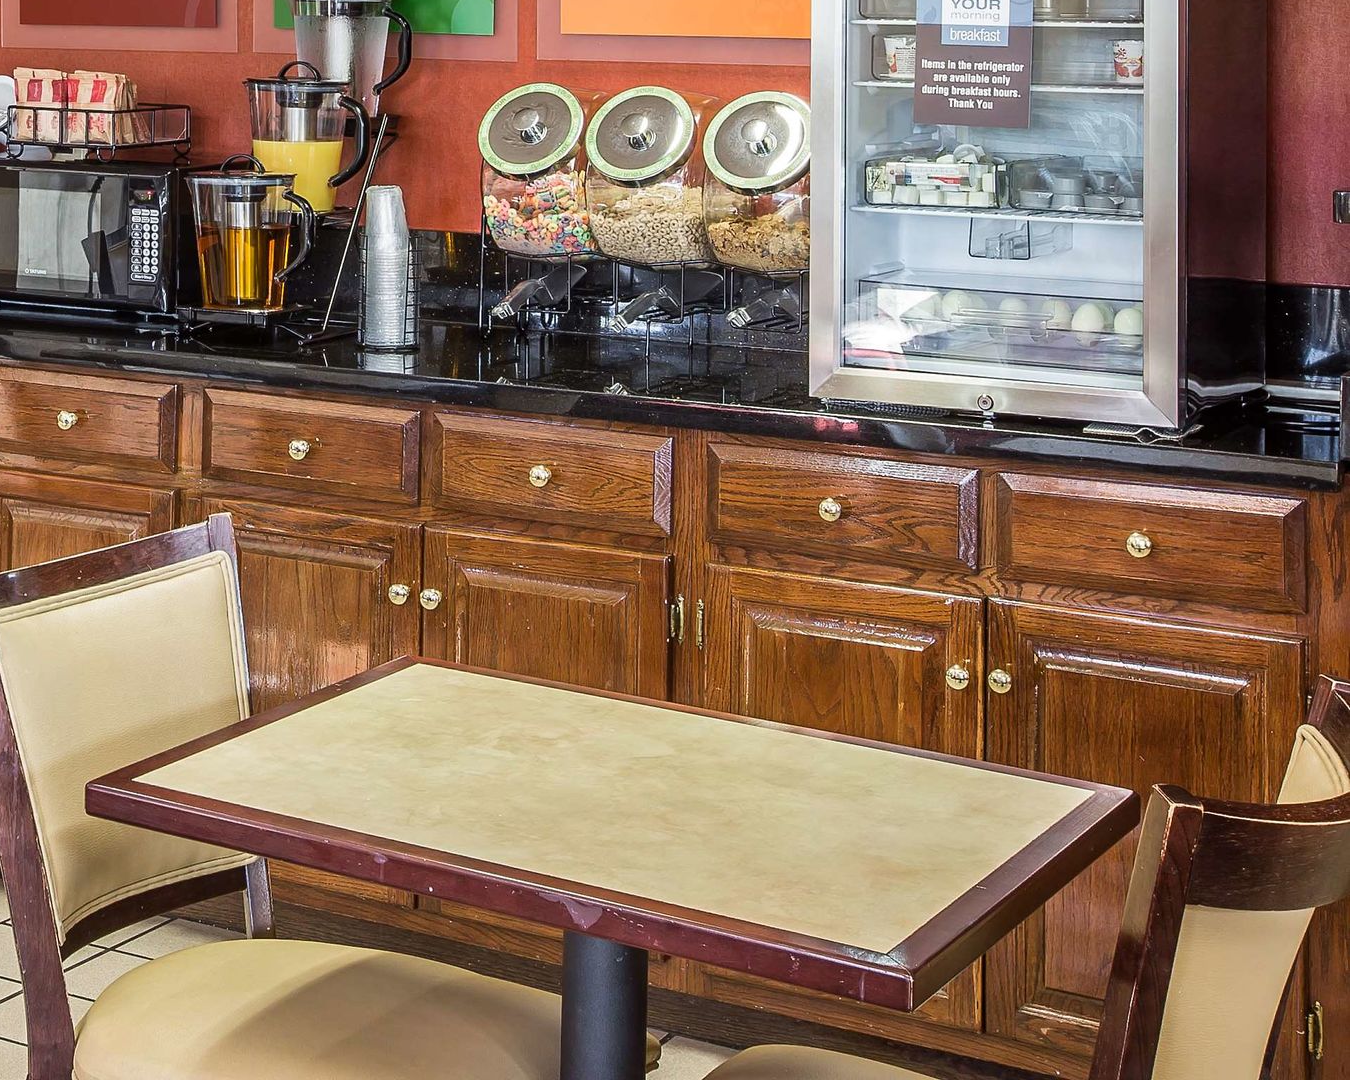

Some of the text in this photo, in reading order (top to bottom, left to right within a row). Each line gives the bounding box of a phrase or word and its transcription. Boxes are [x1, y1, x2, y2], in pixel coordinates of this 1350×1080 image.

[950, 11, 1000, 22] morning
[950, 27, 1001, 42] breakfast
[921, 58, 946, 69] Items
[947, 59, 956, 69] in
[957, 60, 972, 70] the
[973, 61, 1025, 73] refrigerator
[933, 73, 1011, 86] are available only
[921, 85, 1022, 98] during breakfast hours.
[948, 98, 994, 110] Thank You
